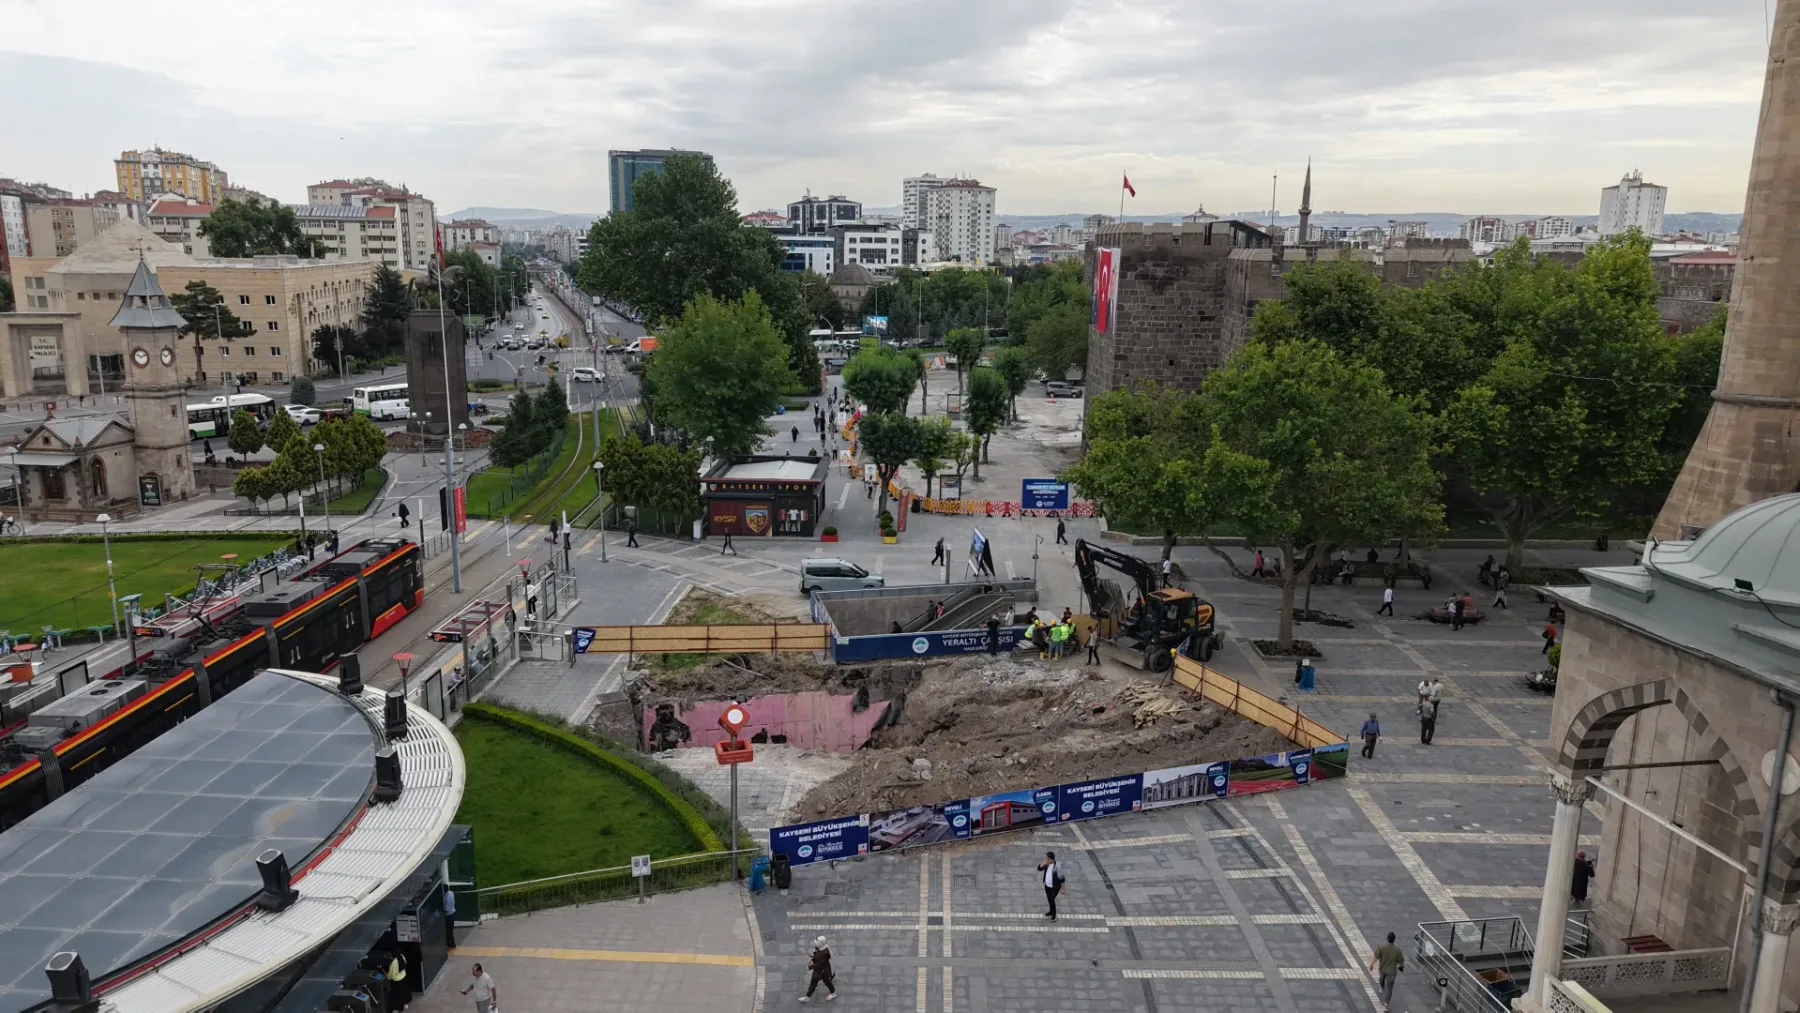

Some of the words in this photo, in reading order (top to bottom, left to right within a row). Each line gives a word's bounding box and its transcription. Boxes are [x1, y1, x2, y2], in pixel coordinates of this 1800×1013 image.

[942, 637, 977, 646] YERALTI
[980, 635, 1013, 645] ÇAŞISI
[1067, 784, 1095, 794] KAYSERİ
[1095, 778, 1136, 790] BÜYÜKŞEHİR
[1083, 788, 1120, 798] BELEDİYESİ
[779, 826, 811, 838] KAYSERİ
[812, 820, 860, 833] BÜYÜKŞEHİR
[798, 830, 842, 843] BELEDİYESİ
